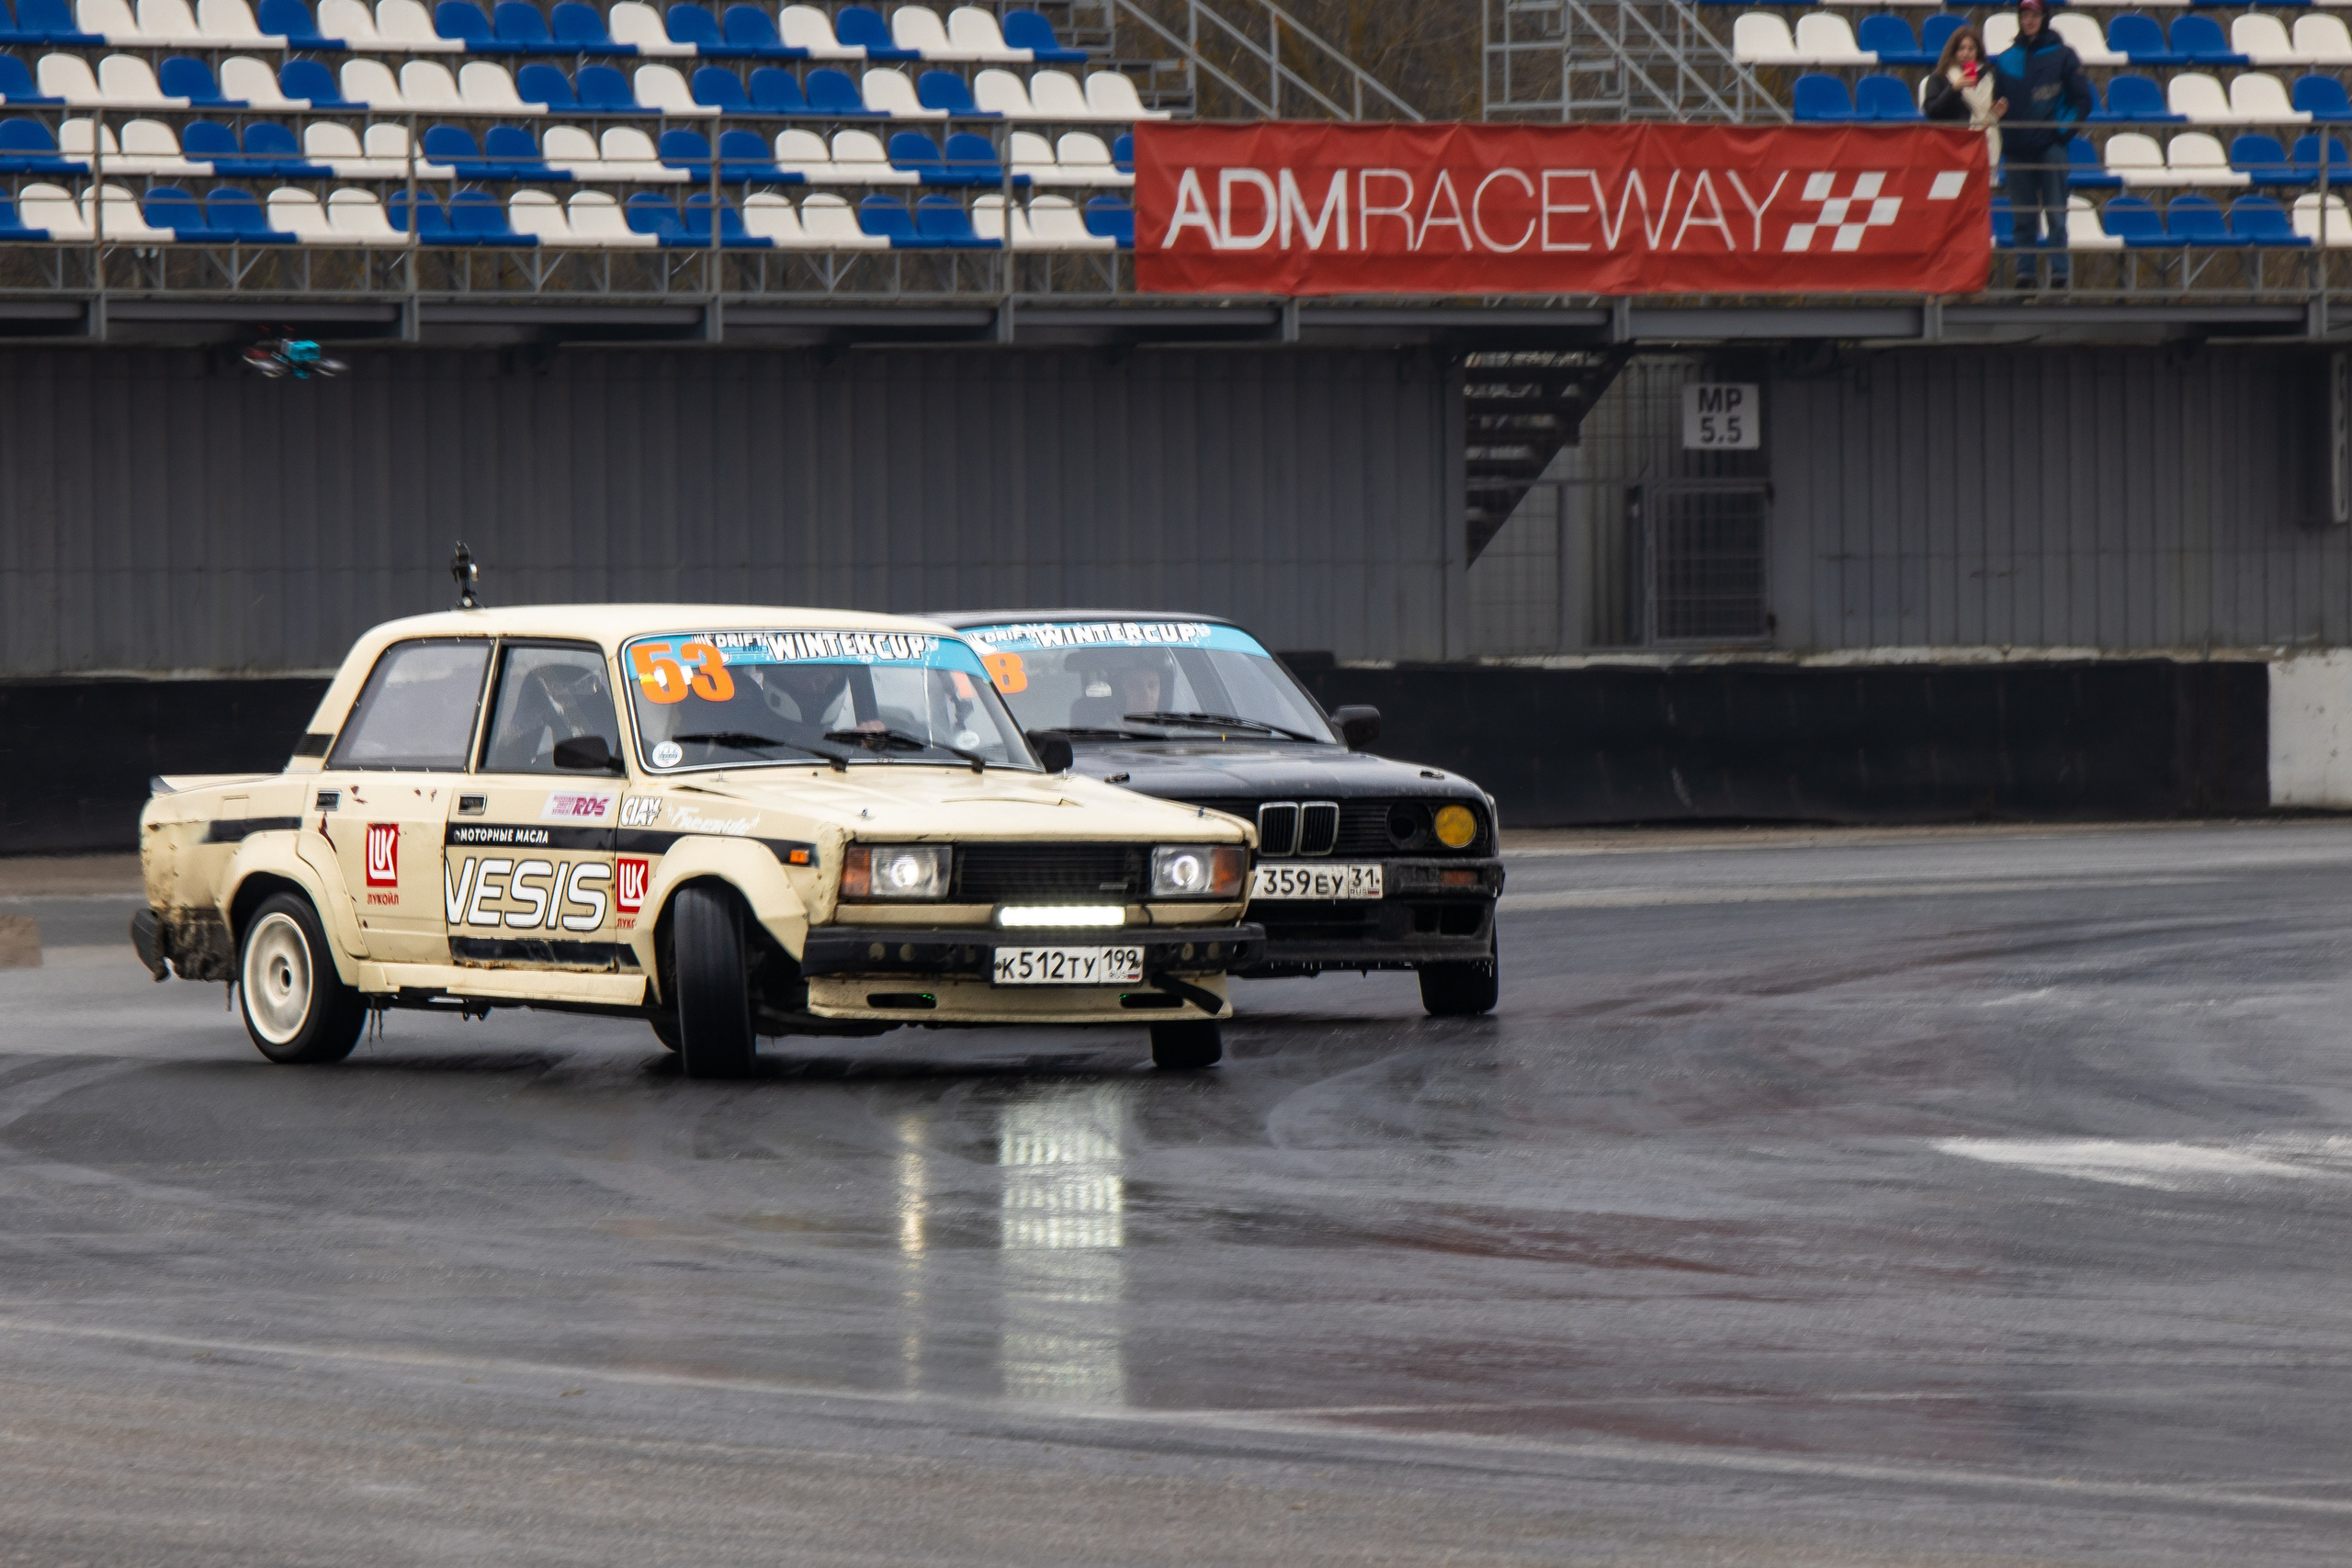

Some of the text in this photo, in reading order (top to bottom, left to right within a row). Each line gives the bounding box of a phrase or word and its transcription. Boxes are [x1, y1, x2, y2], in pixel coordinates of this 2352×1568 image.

[1699, 387, 1743, 412] MP
[1701, 415, 1743, 444] 5.5
[630, 642, 735, 705] 53
[571, 795, 610, 817] RDS
[460, 828, 548, 843] МОТОРНЫЕ МАСЛА
[1250, 869, 1343, 895] 359ЕУ
[367, 891, 399, 905] ЛУКОЙЛ
[1102, 949, 1138, 970] 199
